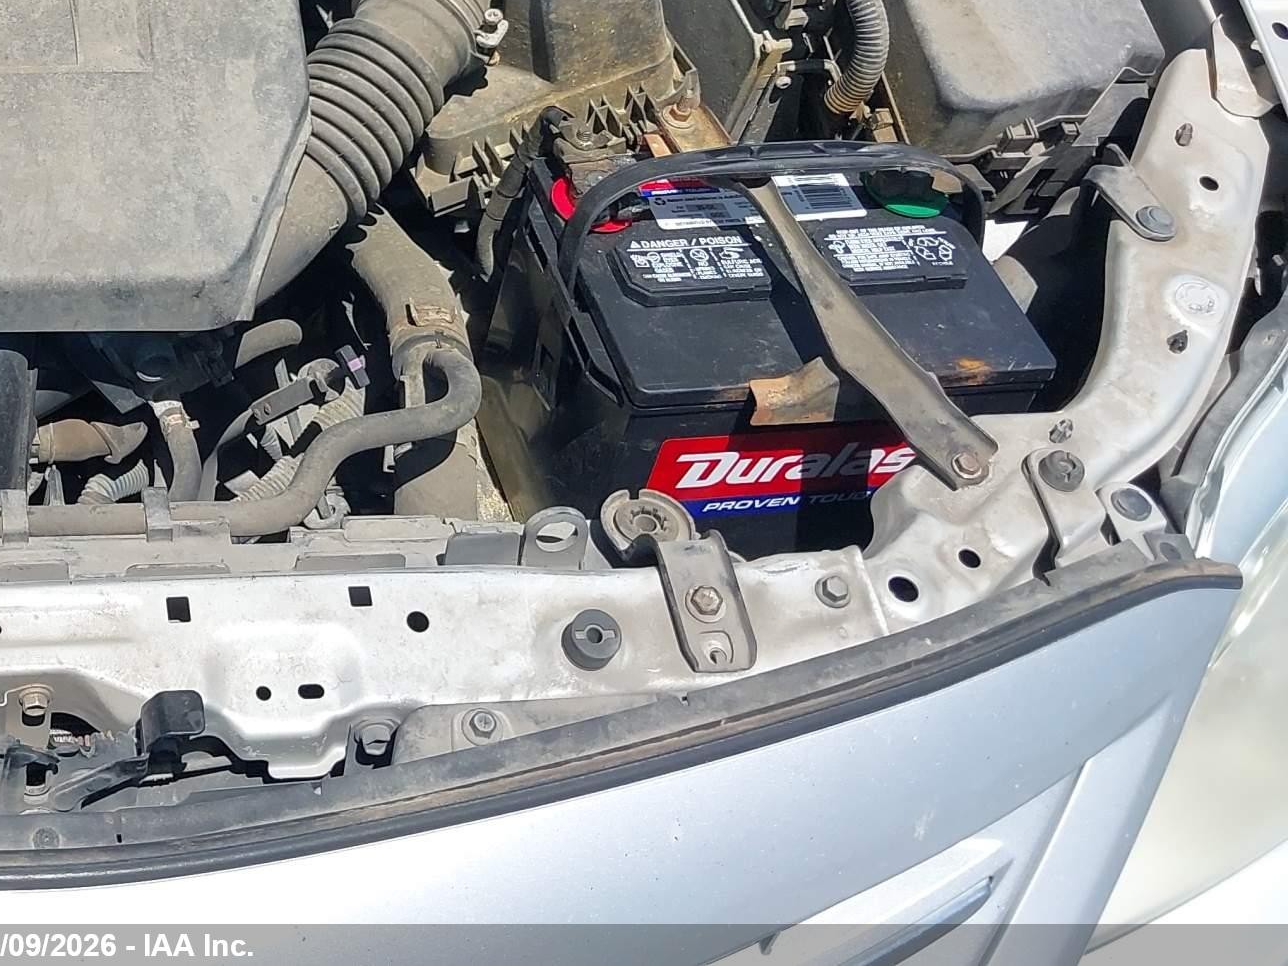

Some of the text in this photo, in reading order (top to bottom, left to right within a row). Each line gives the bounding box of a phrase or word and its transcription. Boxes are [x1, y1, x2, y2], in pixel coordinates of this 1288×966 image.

[640, 236, 743, 248] DANGER / POISON
[675, 442, 917, 489] Duralas
[702, 490, 876, 513] PROVEN TOUG
